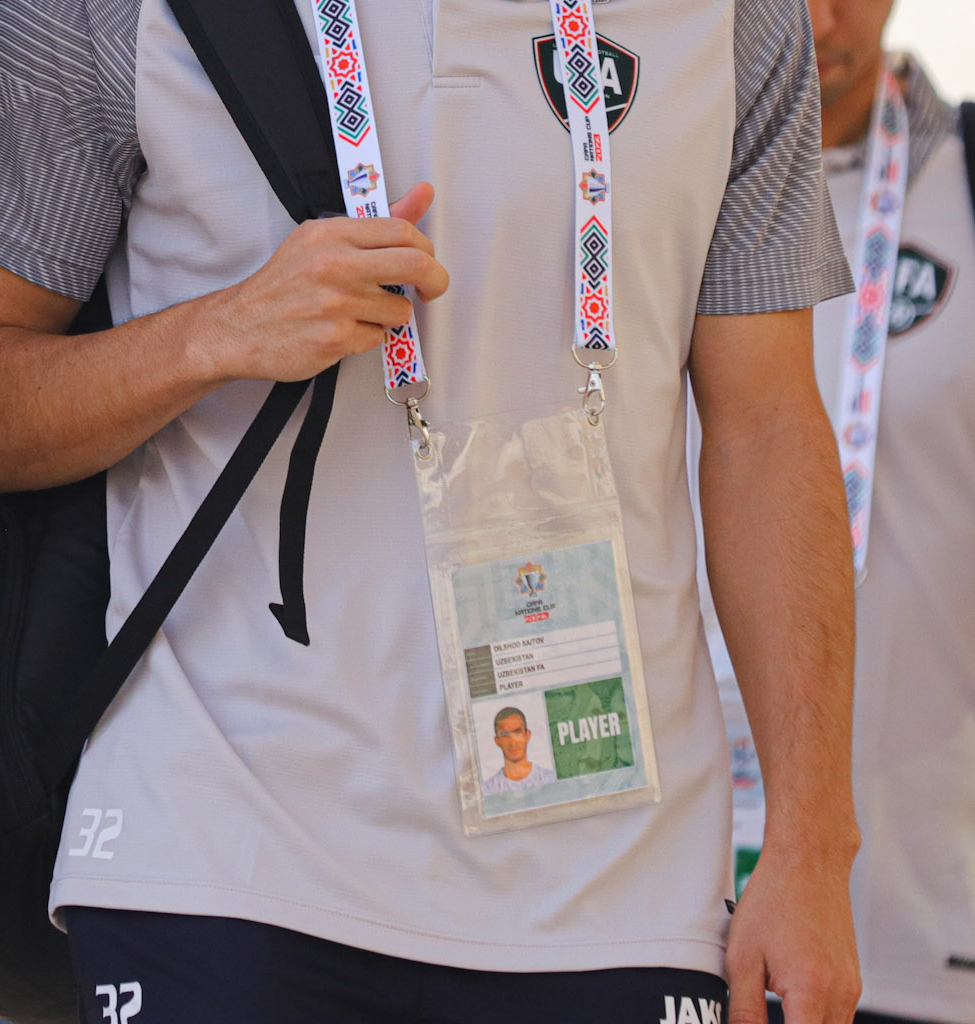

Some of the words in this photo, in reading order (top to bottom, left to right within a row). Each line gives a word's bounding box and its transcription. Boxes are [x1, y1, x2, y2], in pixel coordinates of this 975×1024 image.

[593, 134, 603, 162] 2023
[495, 653, 534, 666] UZBEKISTAN
[497, 664, 536, 679] UZBEKISTAN
[536, 663, 546, 671] FA
[499, 680, 524, 691] PLAYER
[557, 712, 622, 746] PLAYER
[68, 808, 124, 860] 32
[95, 981, 143, 1024] 32
